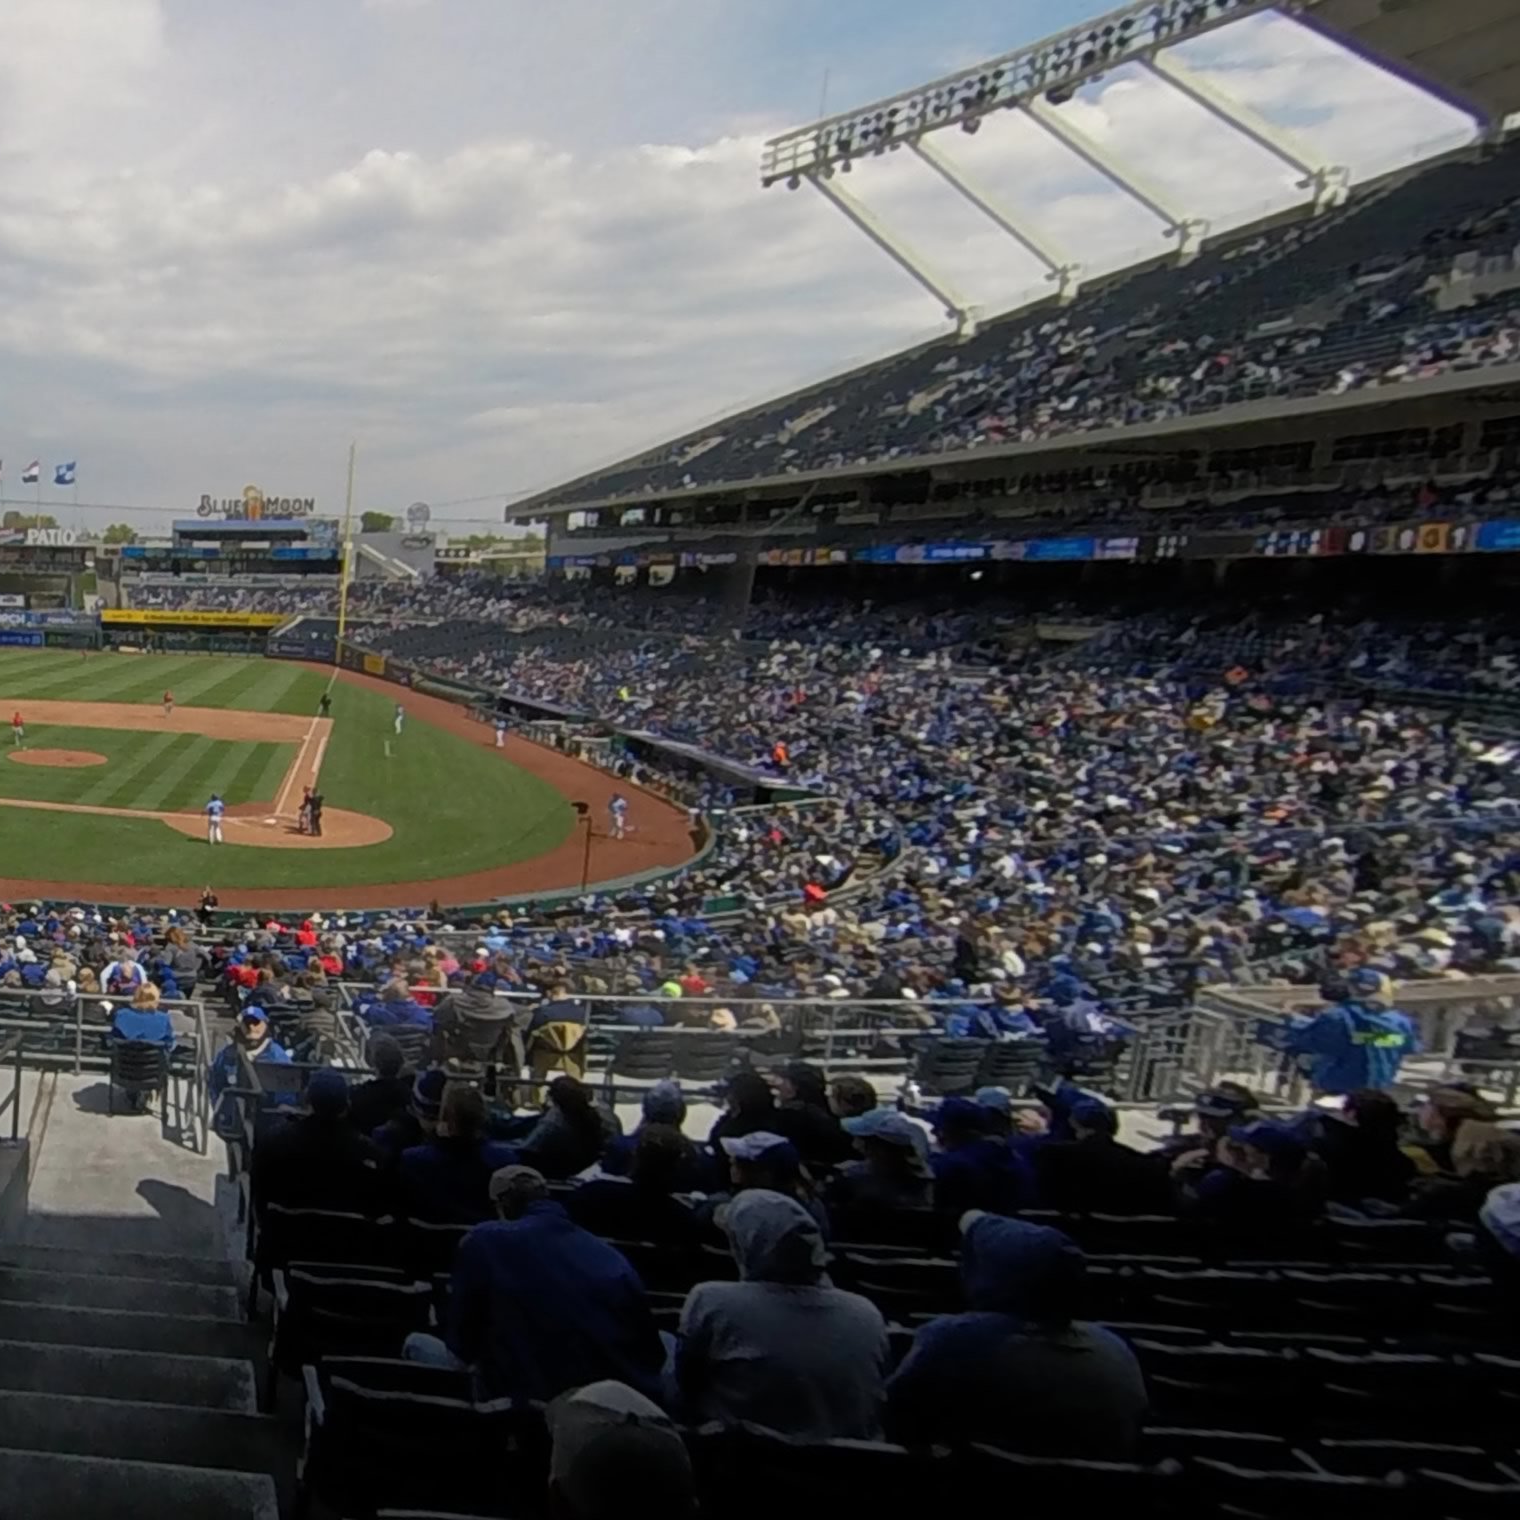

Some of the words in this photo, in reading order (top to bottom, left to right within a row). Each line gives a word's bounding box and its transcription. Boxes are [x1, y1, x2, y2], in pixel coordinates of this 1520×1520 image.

[196, 494, 241, 518] BLUE
[265, 497, 315, 514] MOON
[26, 528, 77, 546] PATIO
